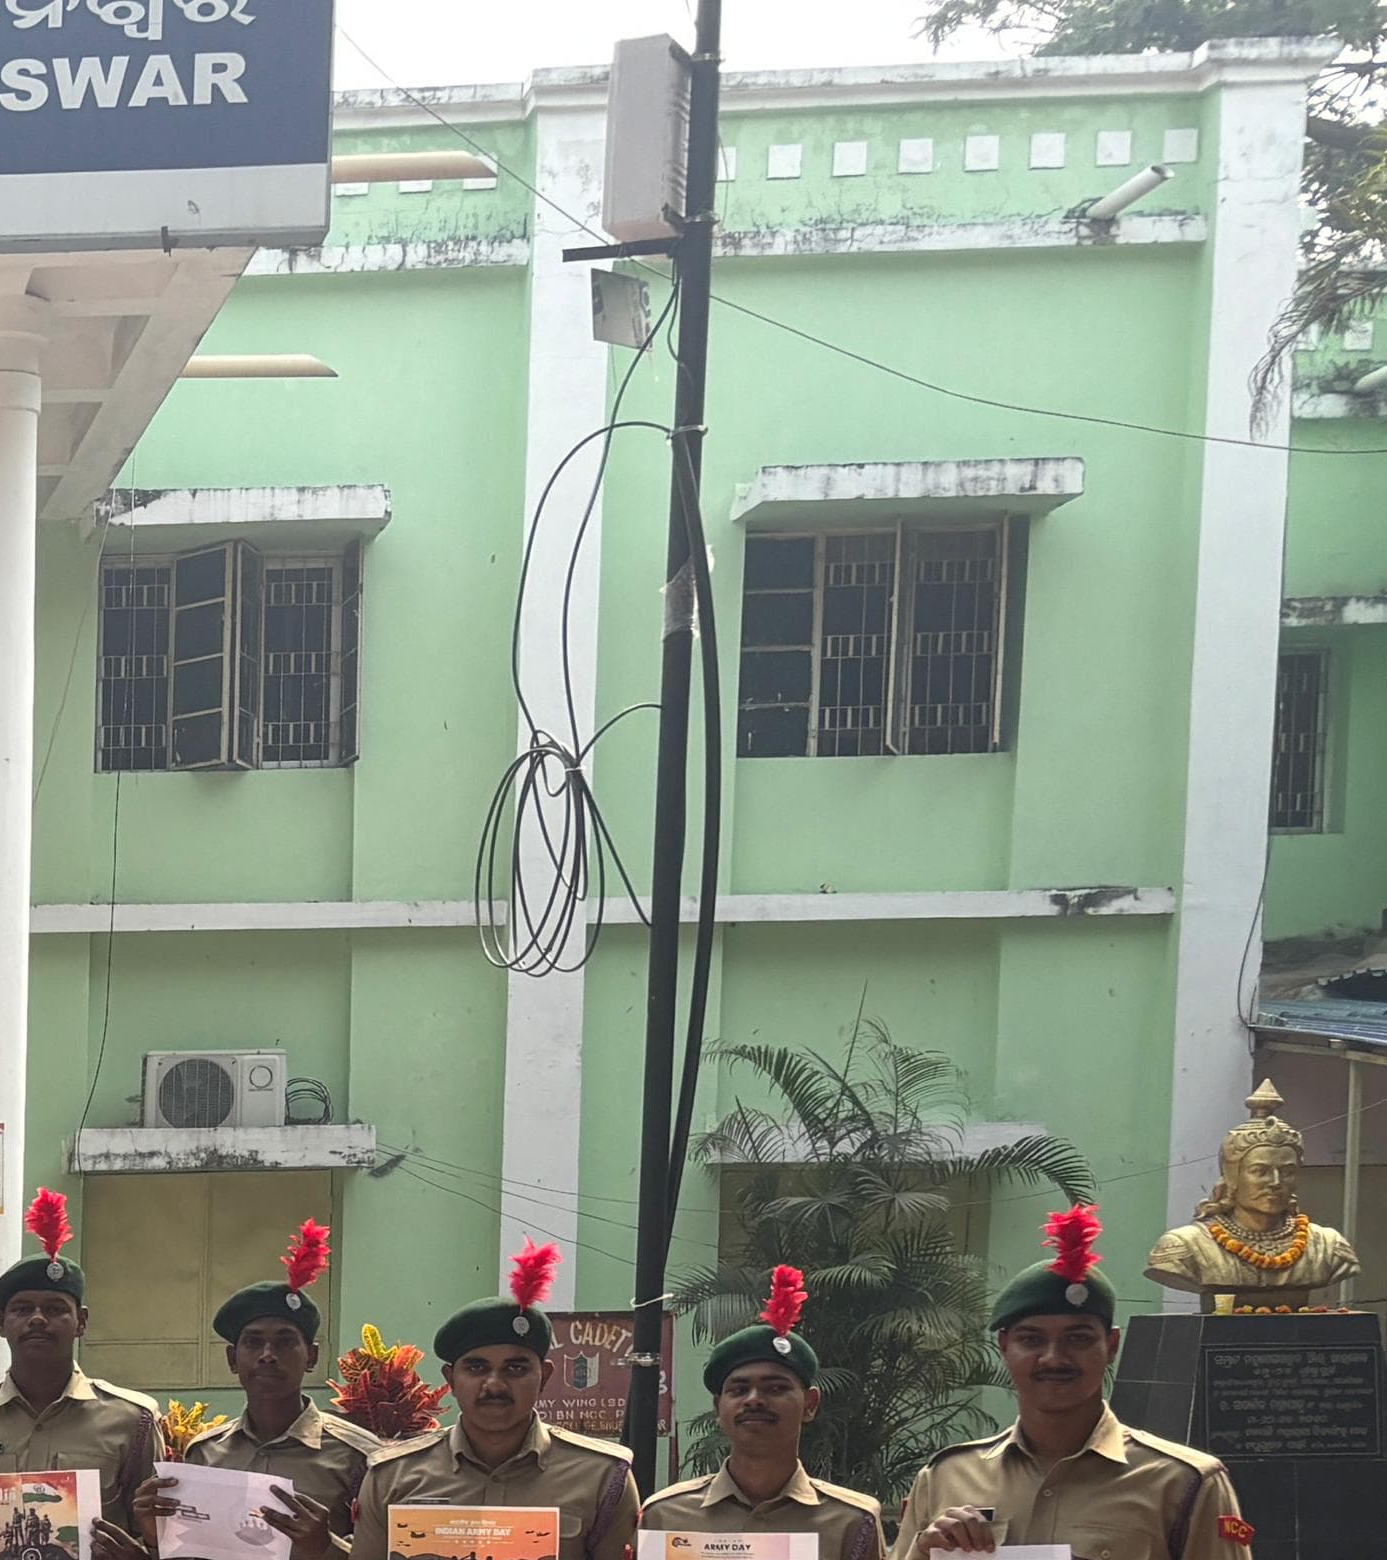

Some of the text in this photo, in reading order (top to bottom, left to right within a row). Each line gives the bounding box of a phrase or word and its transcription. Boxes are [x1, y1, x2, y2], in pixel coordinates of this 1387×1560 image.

[570, 1321, 632, 1353] CADET
[563, 1399, 597, 1408] WING
[557, 1411, 575, 1420] BN
[580, 1411, 607, 1420] NCC
[703, 1543, 751, 1551] ARMY DAY
